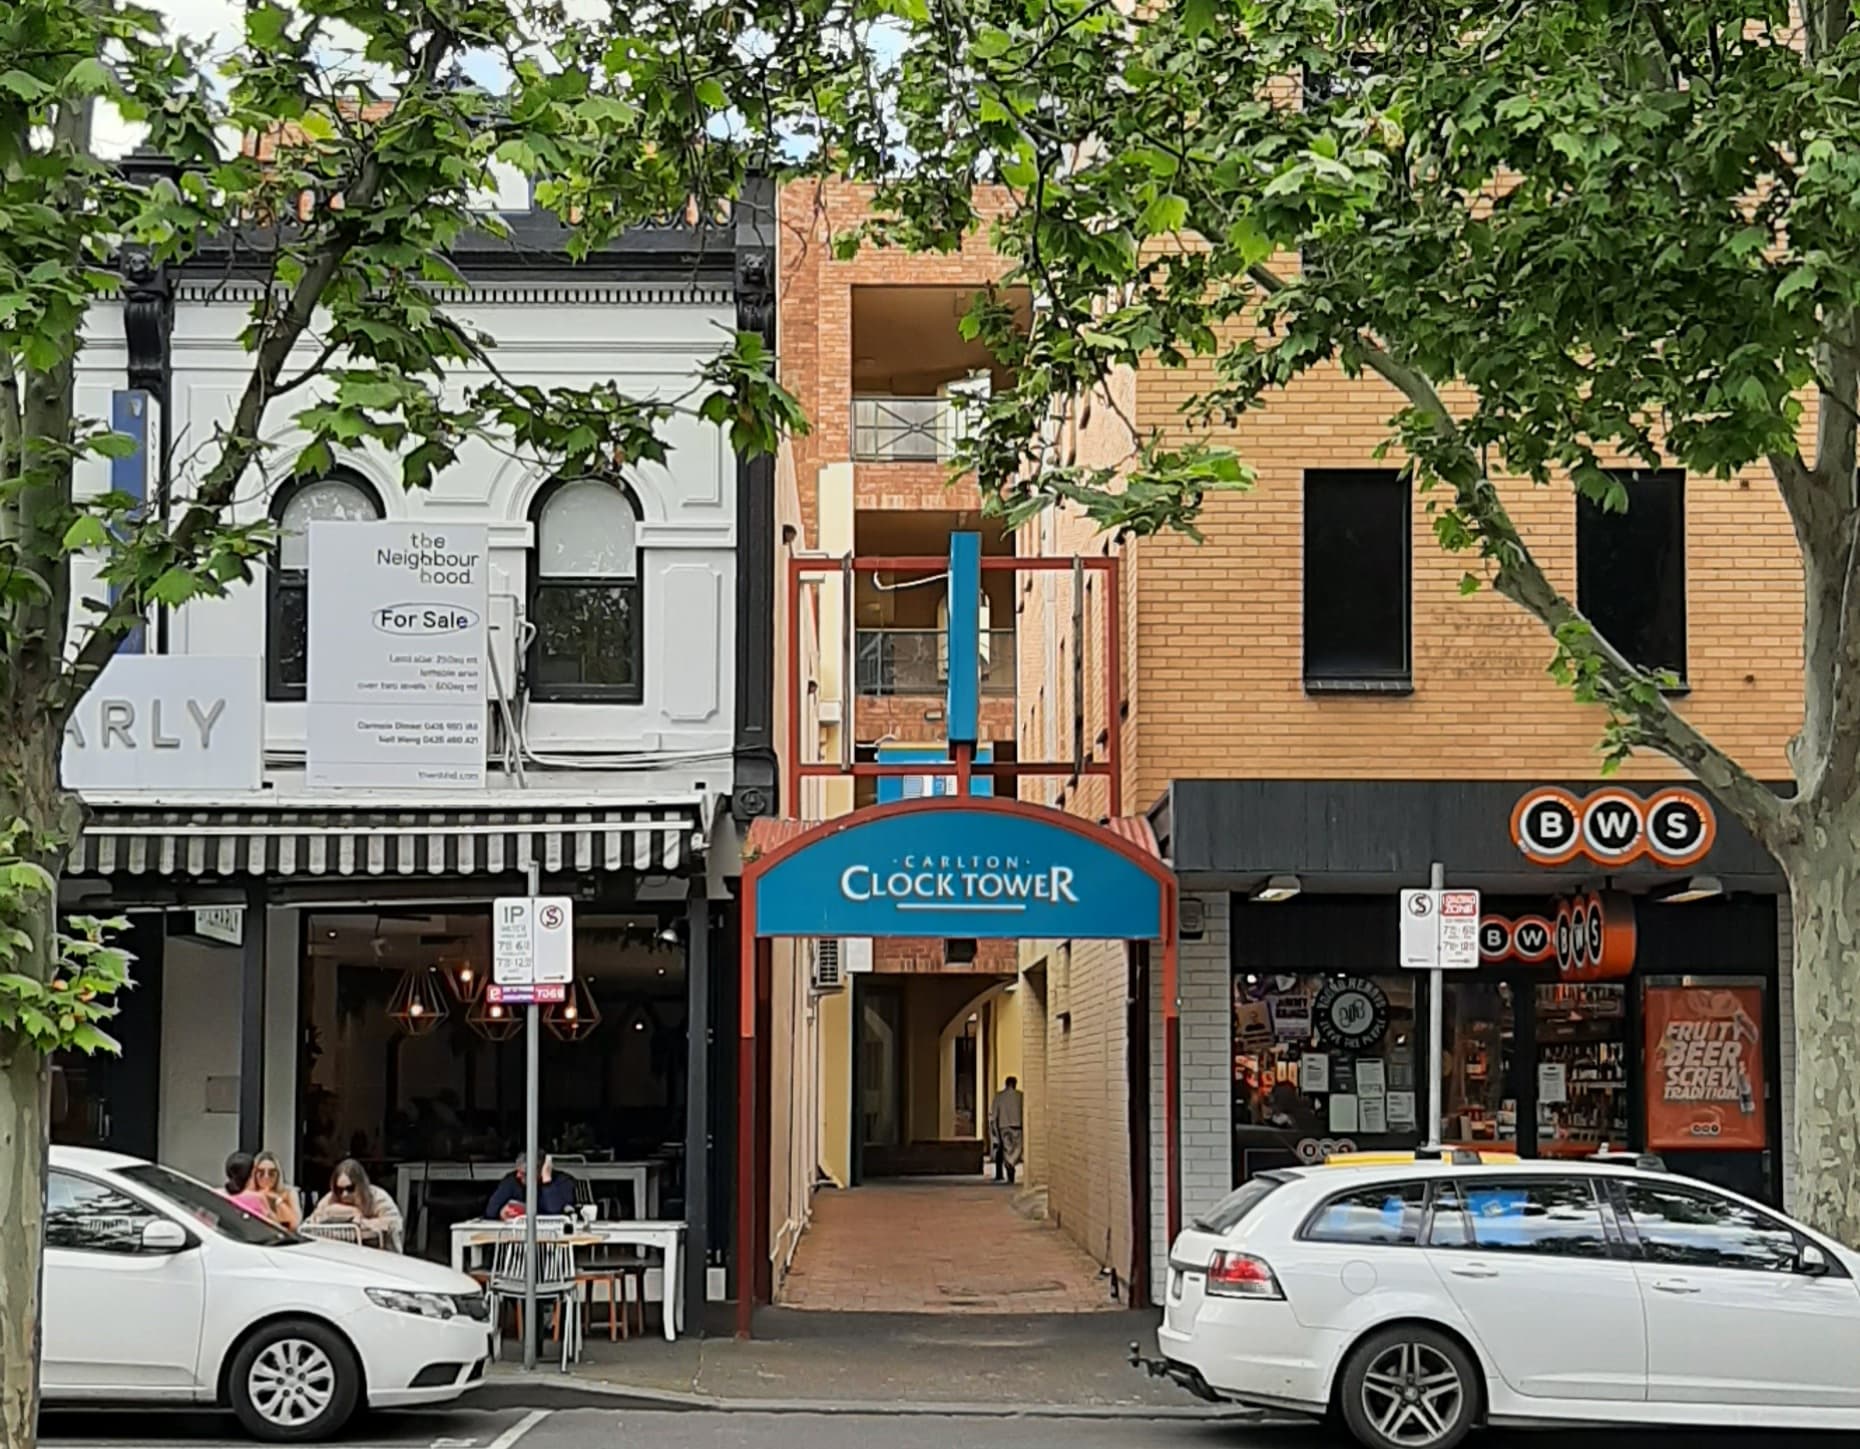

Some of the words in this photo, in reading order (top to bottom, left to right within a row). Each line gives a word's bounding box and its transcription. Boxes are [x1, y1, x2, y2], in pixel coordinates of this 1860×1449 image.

[410, 533, 446, 549] the
[377, 549, 479, 569] Neighbour
[381, 609, 418, 628] For
[423, 610, 469, 629] Sale
[1539, 810, 1689, 840] BWS
[904, 855, 1019, 869] CARLTON
[1487, 929, 1543, 947] BW
[1560, 918, 1599, 955] BWS
[1666, 1021, 1742, 1040] FRUITY
[1664, 1040, 1742, 1067] BEER
[1664, 1066, 1739, 1090] SCREW
